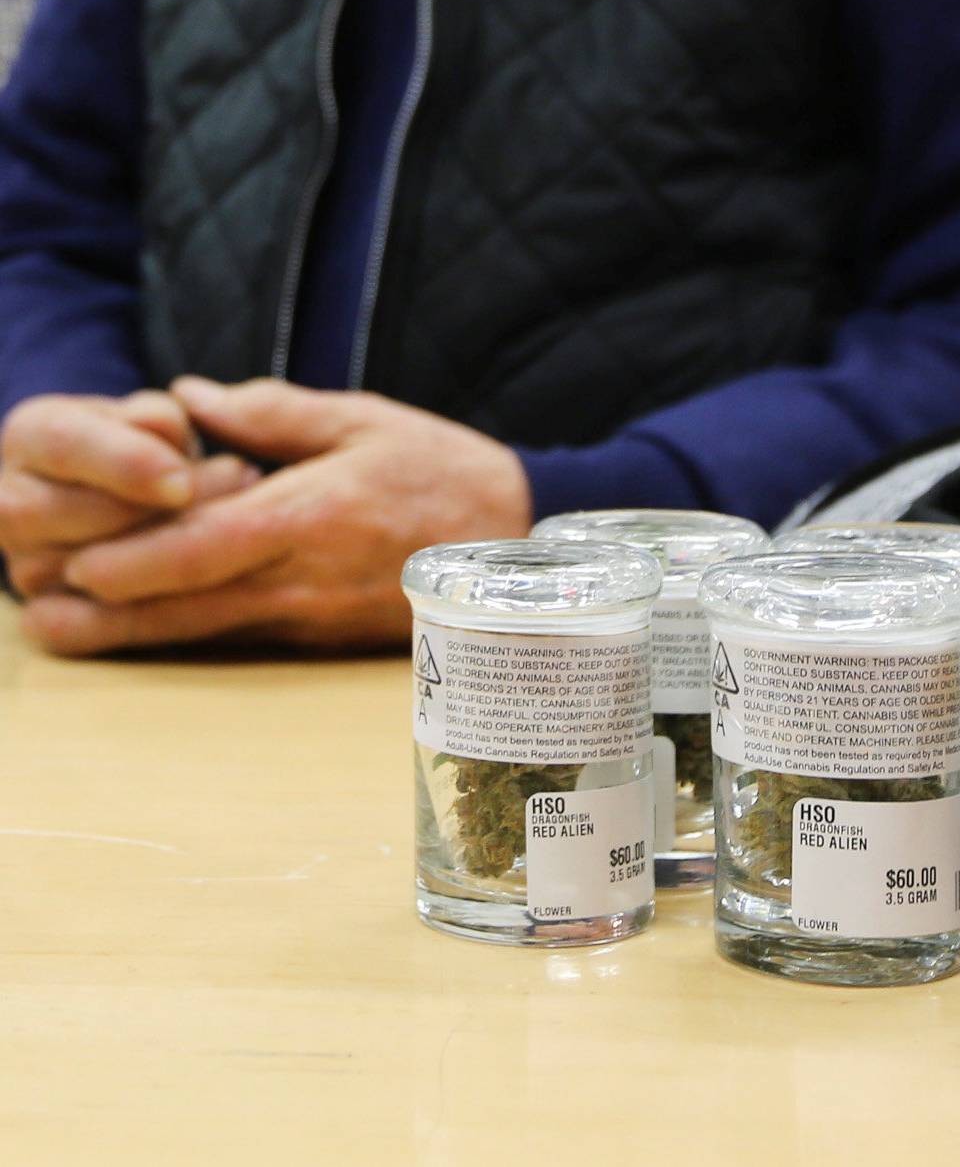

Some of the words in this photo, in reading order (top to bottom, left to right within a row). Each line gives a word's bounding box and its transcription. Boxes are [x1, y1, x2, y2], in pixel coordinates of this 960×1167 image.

[447, 641, 511, 656] GOVERNMENT
[514, 648, 566, 658] WARNING:
[569, 649, 590, 658] THIS
[593, 644, 630, 656] PACKAGE
[744, 648, 811, 664] GOVERNMENT
[873, 658, 895, 667] THIS
[899, 655, 938, 666] PACKAGE
[447, 654, 508, 669] CONTROLLED
[578, 661, 602, 669] KEEP
[604, 659, 620, 668] OUT
[623, 657, 631, 666] OF
[744, 661, 807, 678] CONTROLLED
[810, 669, 880, 680] SUBSTANCE.
[882, 671, 909, 680] KEEP
[911, 670, 928, 679] OUT
[931, 668, 940, 677] OF
[447, 666, 490, 680] CHILDREN
[493, 672, 513, 681] AND
[567, 672, 613, 683] CANNABIS
[446, 678, 456, 687] BY
[458, 681, 504, 694] PERSONS
[507, 685, 517, 694] 21
[520, 686, 556, 696] YEARS
[559, 687, 572, 696] OF
[575, 686, 594, 695] AGE
[597, 685, 609, 694] OR
[744, 674, 789, 689] CHILDREN
[792, 681, 813, 690] AND
[817, 684, 867, 694] ANIMALS.
[871, 683, 921, 693] CANNABIS
[923, 682, 938, 690] MAY
[447, 691, 491, 705] QUALIFIED
[541, 698, 591, 708] CANNABIS
[594, 697, 611, 707] USE
[744, 688, 755, 696] BY
[757, 689, 803, 704] PERSONS
[807, 696, 817, 704] 21
[822, 697, 859, 706] YEARS
[862, 698, 878, 706] OF
[880, 698, 901, 706] AGE
[904, 697, 917, 706] OR
[920, 695, 945, 705] OLDER
[446, 703, 462, 711] MAY
[465, 706, 476, 715] BE
[533, 711, 606, 721] CONSUMPTION
[744, 700, 791, 715] QUALIFIED
[795, 709, 840, 719] PATIENT.
[844, 710, 897, 720] CANNABIS
[901, 710, 919, 719] USE
[447, 715, 470, 726] DRIVE
[473, 721, 492, 730] AND
[495, 721, 543, 733] OPERATE
[607, 719, 634, 730] PLEASE
[744, 713, 761, 723] MAY
[764, 717, 774, 726] BE
[835, 724, 914, 733] CONSUMPTION
[916, 723, 928, 732] OF
[446, 730, 474, 740] product
[475, 734, 491, 742] has
[493, 736, 507, 744] not
[510, 737, 533, 745] been
[537, 738, 564, 746] tested
[567, 738, 577, 746] as
[580, 735, 612, 748] required
[614, 735, 623, 744] by
[745, 726, 769, 736] DRIVE
[772, 732, 792, 742] AND
[796, 731, 846, 746] OPERATE
[916, 733, 944, 745] PLEASE
[485, 746, 528, 758] Cannabis
[530, 750, 578, 760] Regulation
[581, 750, 597, 758] and
[600, 746, 622, 758] Safety
[745, 740, 772, 753] product
[775, 745, 790, 754] has
[794, 748, 808, 757] not
[811, 749, 835, 759] been
[839, 751, 868, 760] tested
[872, 753, 882, 761] as
[885, 751, 922, 762] required
[922, 750, 930, 759] by
[745, 753, 782, 767] Adult-Use
[785, 760, 830, 772] Cannabis
[833, 764, 885, 774] Regulation
[888, 764, 904, 773] and
[907, 761, 931, 773] Safety
[532, 797, 565, 814] HSO
[800, 803, 835, 824] HSO
[532, 812, 590, 824] DRAGONFISH
[533, 826, 556, 838] RED
[561, 822, 594, 837] ALIEN
[800, 821, 863, 836] DRAGONFISH
[800, 834, 824, 847] RED
[830, 836, 867, 851] ALIEN
[610, 840, 645, 867] $60.00
[610, 871, 624, 883] 3.5
[886, 866, 937, 890] $60.00
[886, 892, 903, 905] 3.5
[908, 889, 937, 904] GRAM
[534, 906, 572, 916] FLOWER
[798, 918, 838, 932] FLOWER
